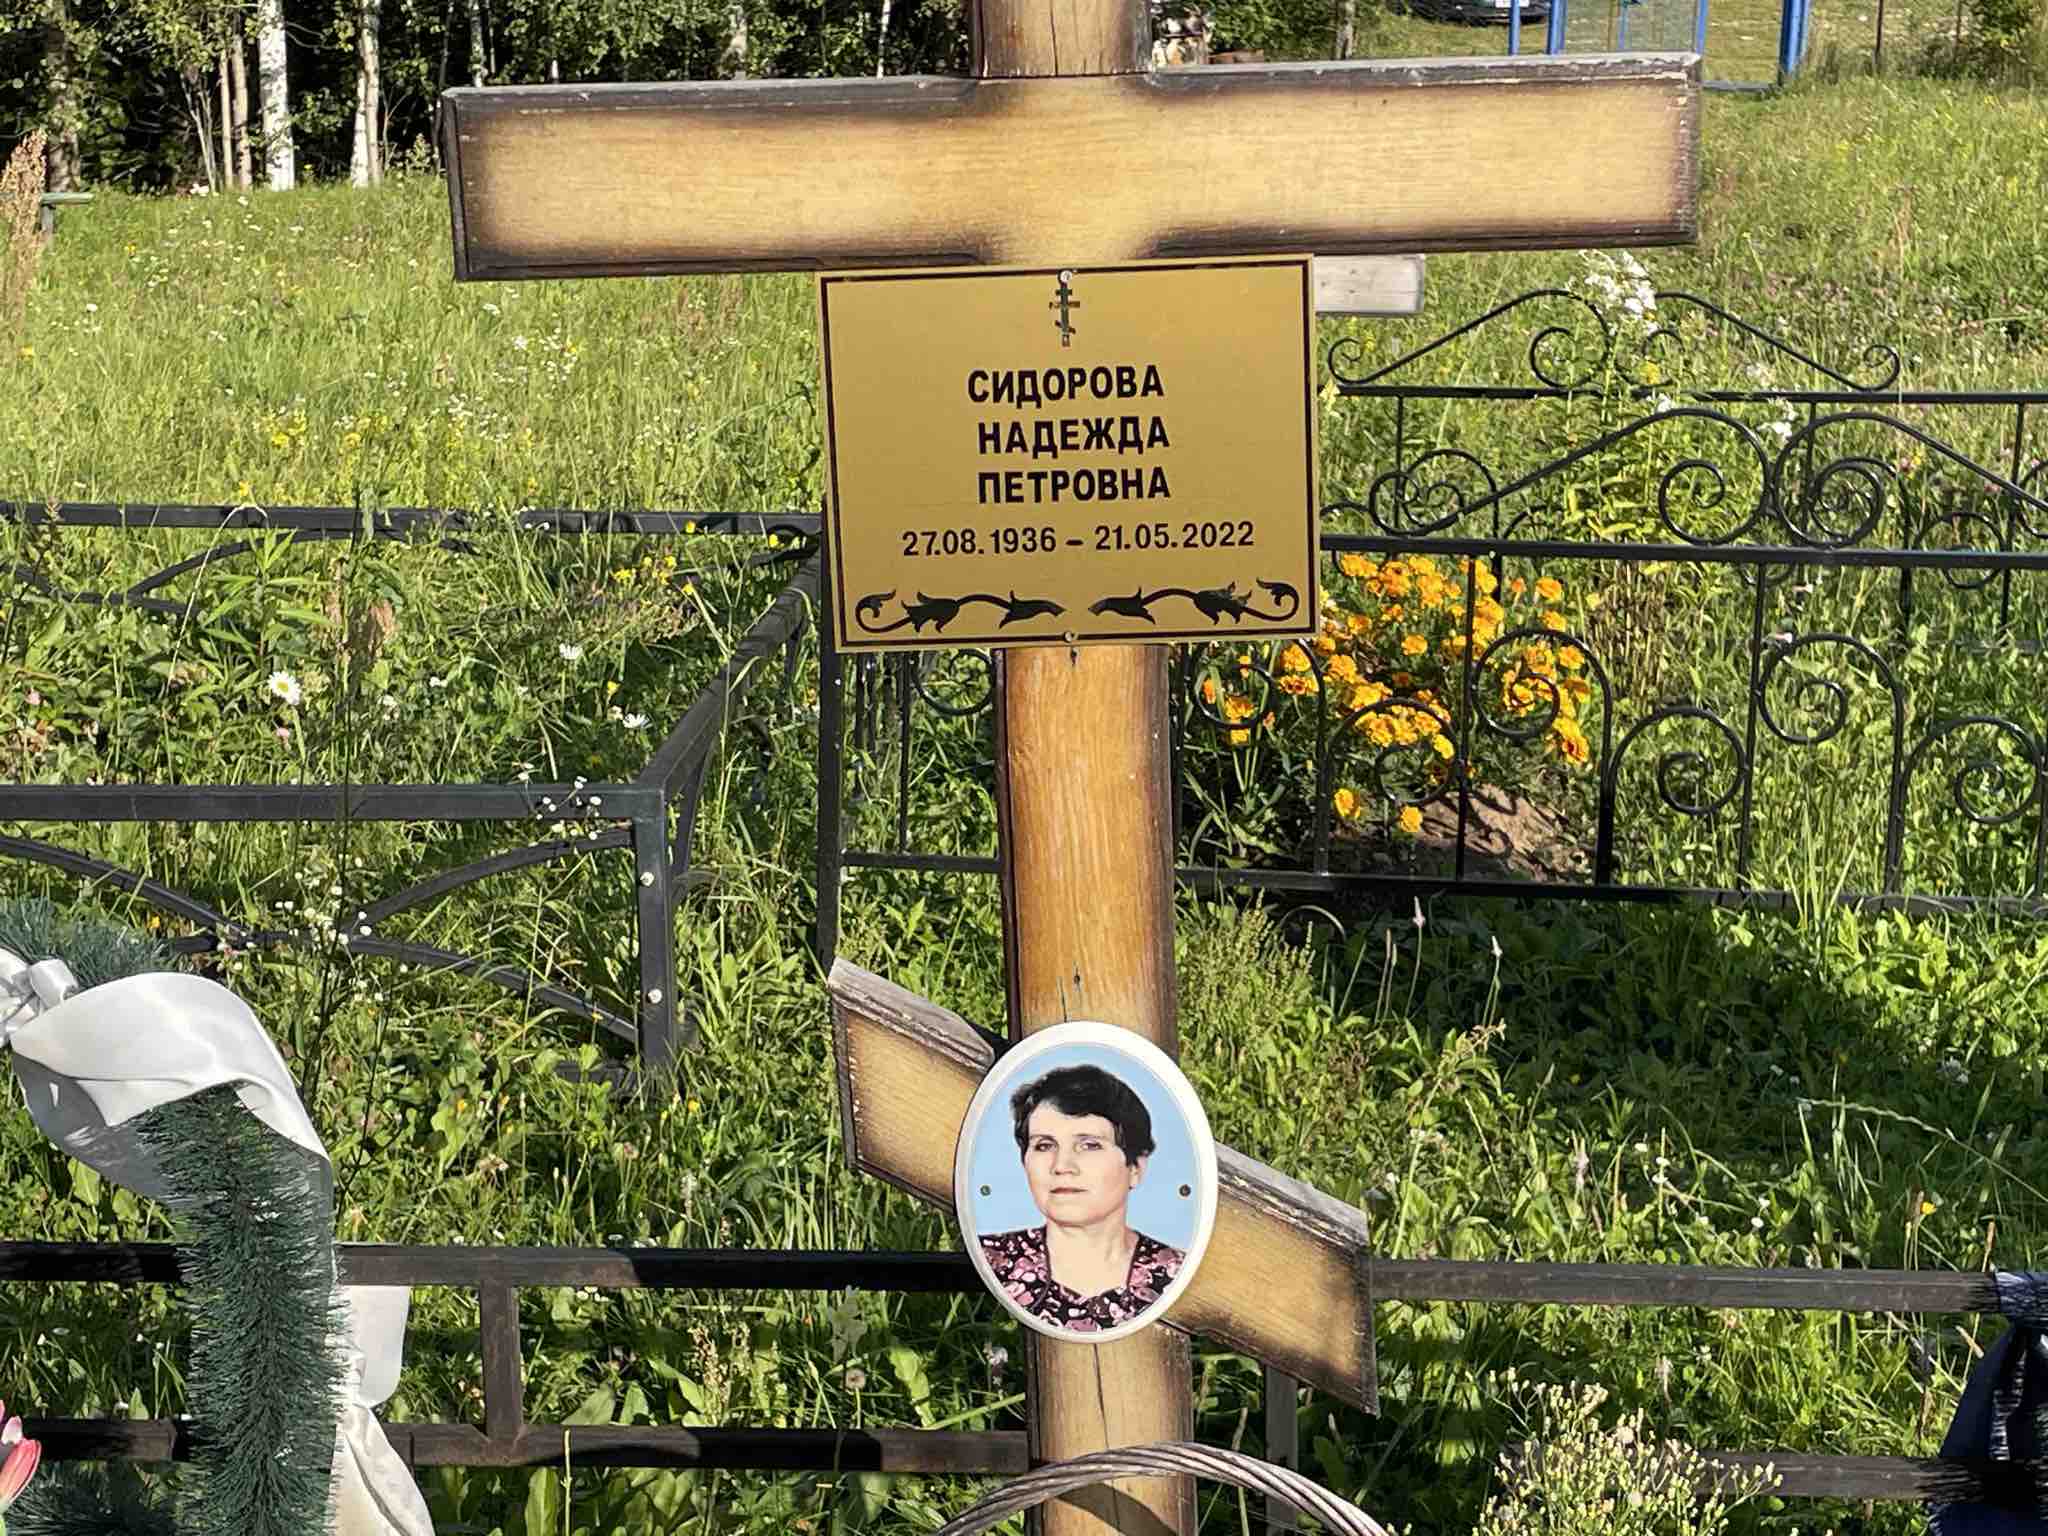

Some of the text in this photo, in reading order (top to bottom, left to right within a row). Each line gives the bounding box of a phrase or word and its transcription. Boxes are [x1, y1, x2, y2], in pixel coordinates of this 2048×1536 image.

[967, 364, 1165, 410] СИДОРОВА
[978, 415, 1170, 460] НАДЕЖДА
[978, 466, 1171, 505] ПЕТРОВНА
[902, 526, 1057, 557] 27.08.1936
[1094, 520, 1255, 551] 21.05.2022
